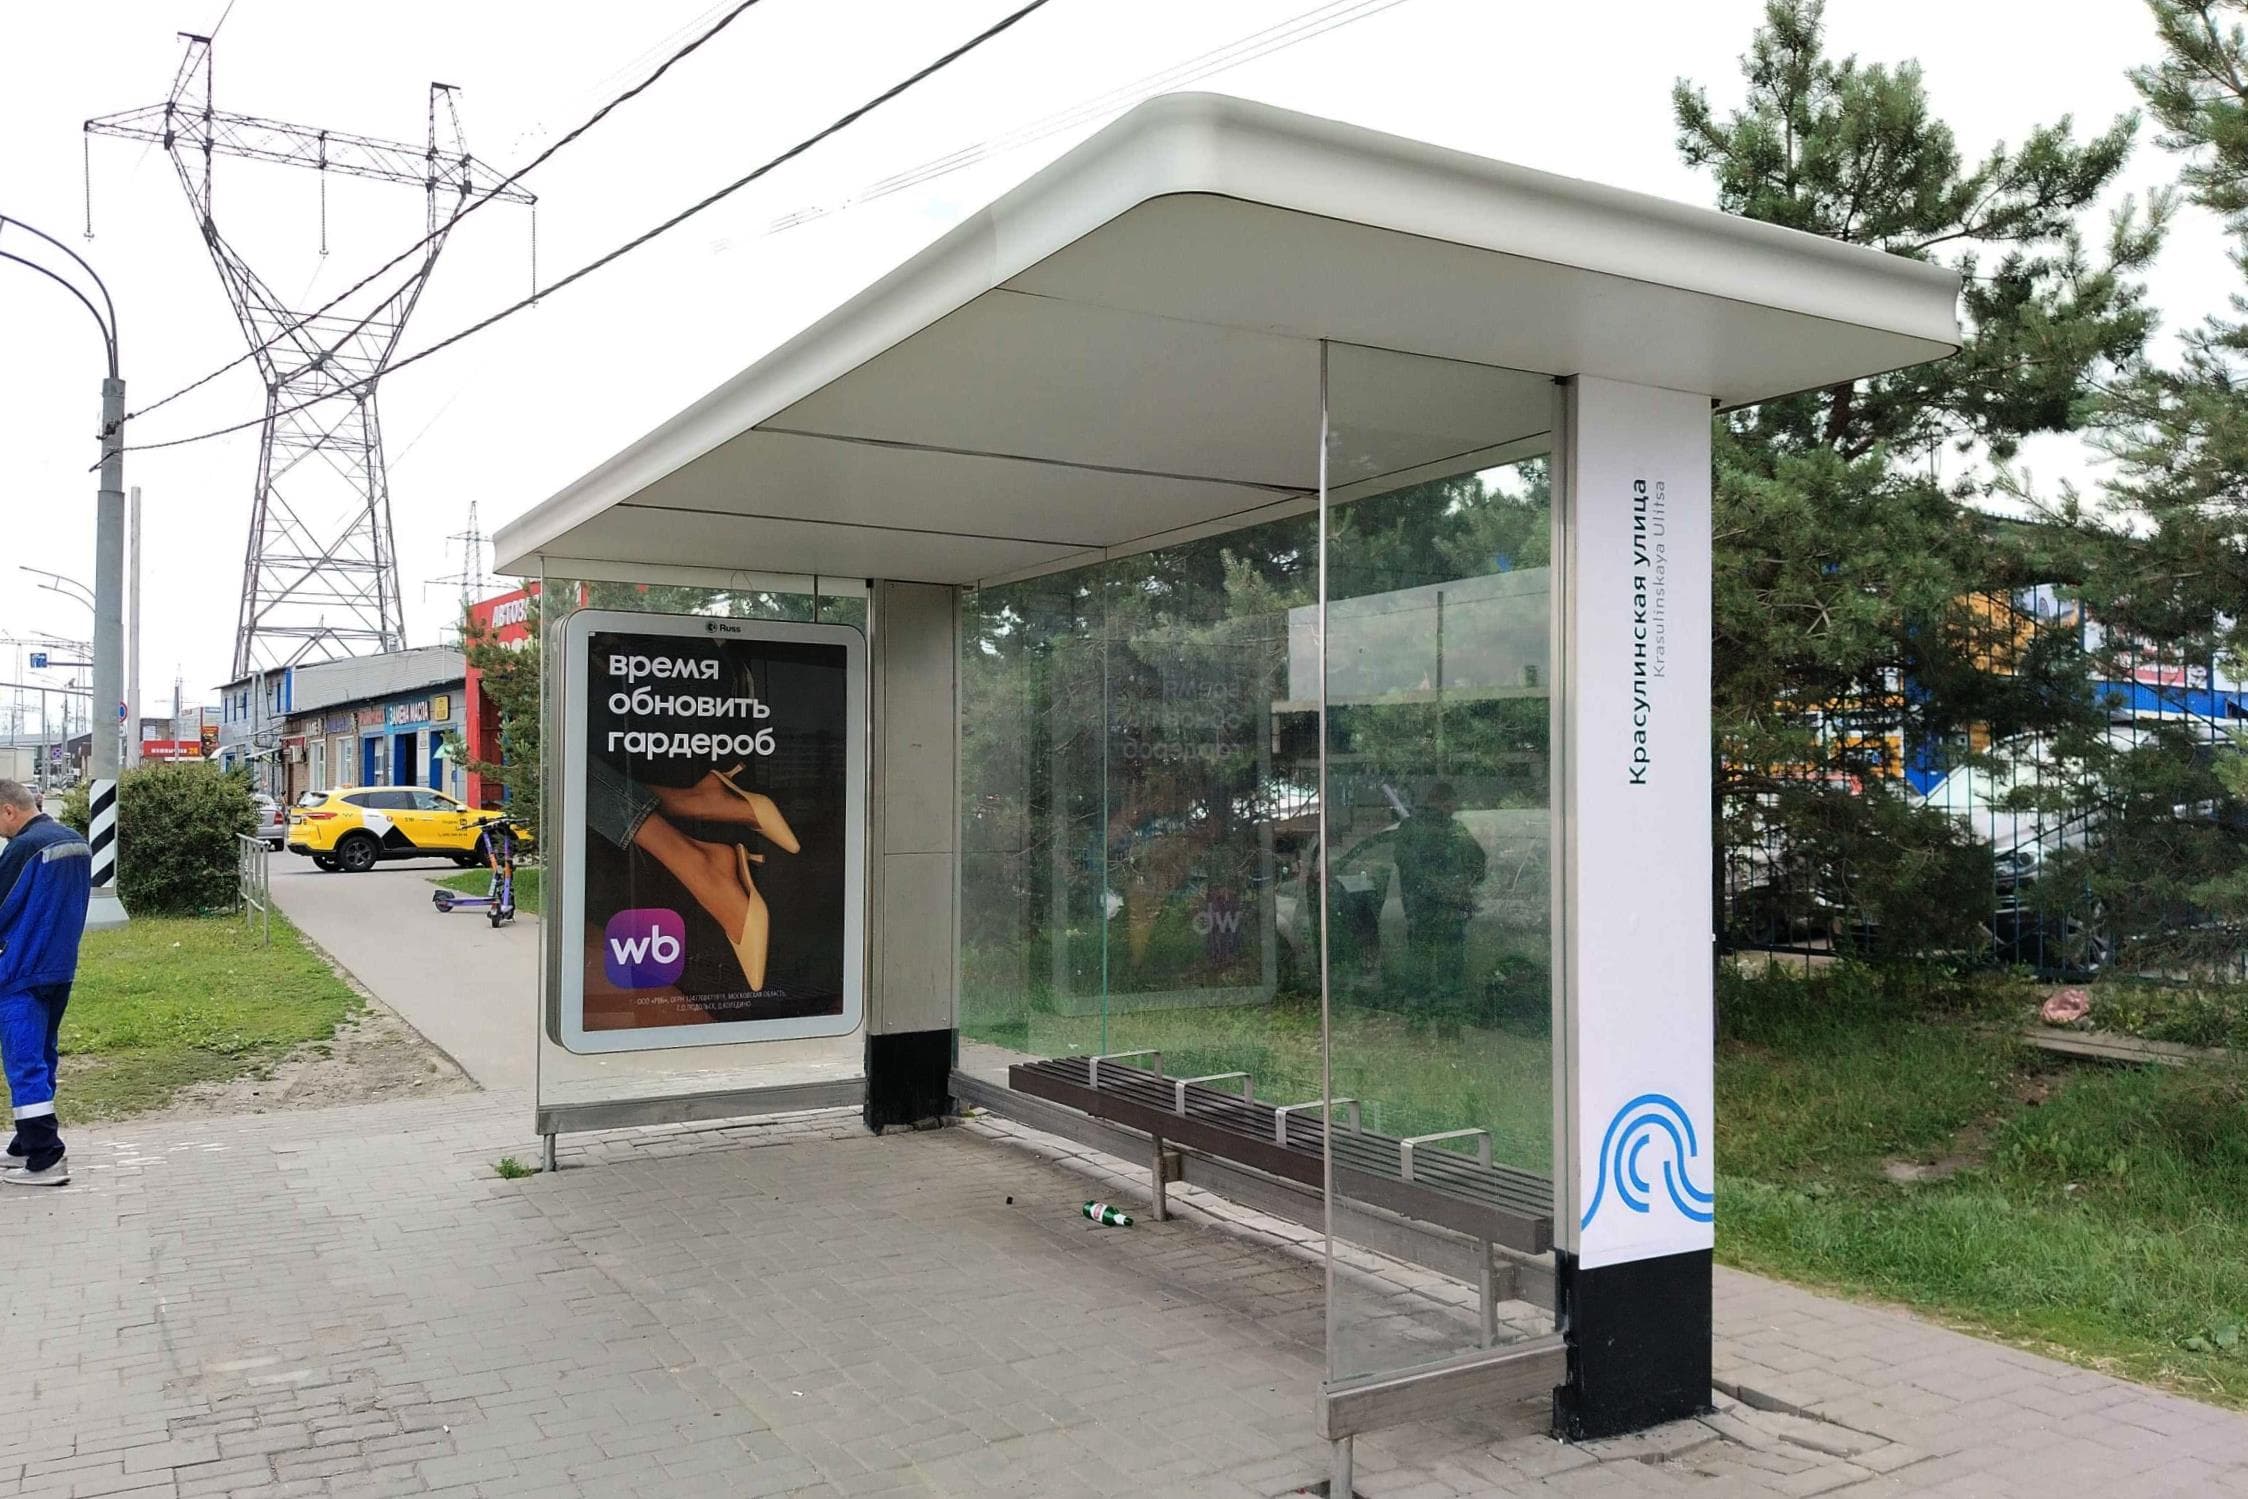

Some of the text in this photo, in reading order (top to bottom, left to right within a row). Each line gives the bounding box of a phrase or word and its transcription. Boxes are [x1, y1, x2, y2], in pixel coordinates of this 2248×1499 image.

[1653, 480, 1667, 678] Krasulinskaya Ulitsa
[719, 624, 741, 633] Russ
[1629, 478, 1651, 785] Красулинская улица
[609, 654, 719, 684] время
[608, 686, 771, 719] обновить
[608, 727, 776, 762] гардероб
[610, 925, 680, 965] wb
